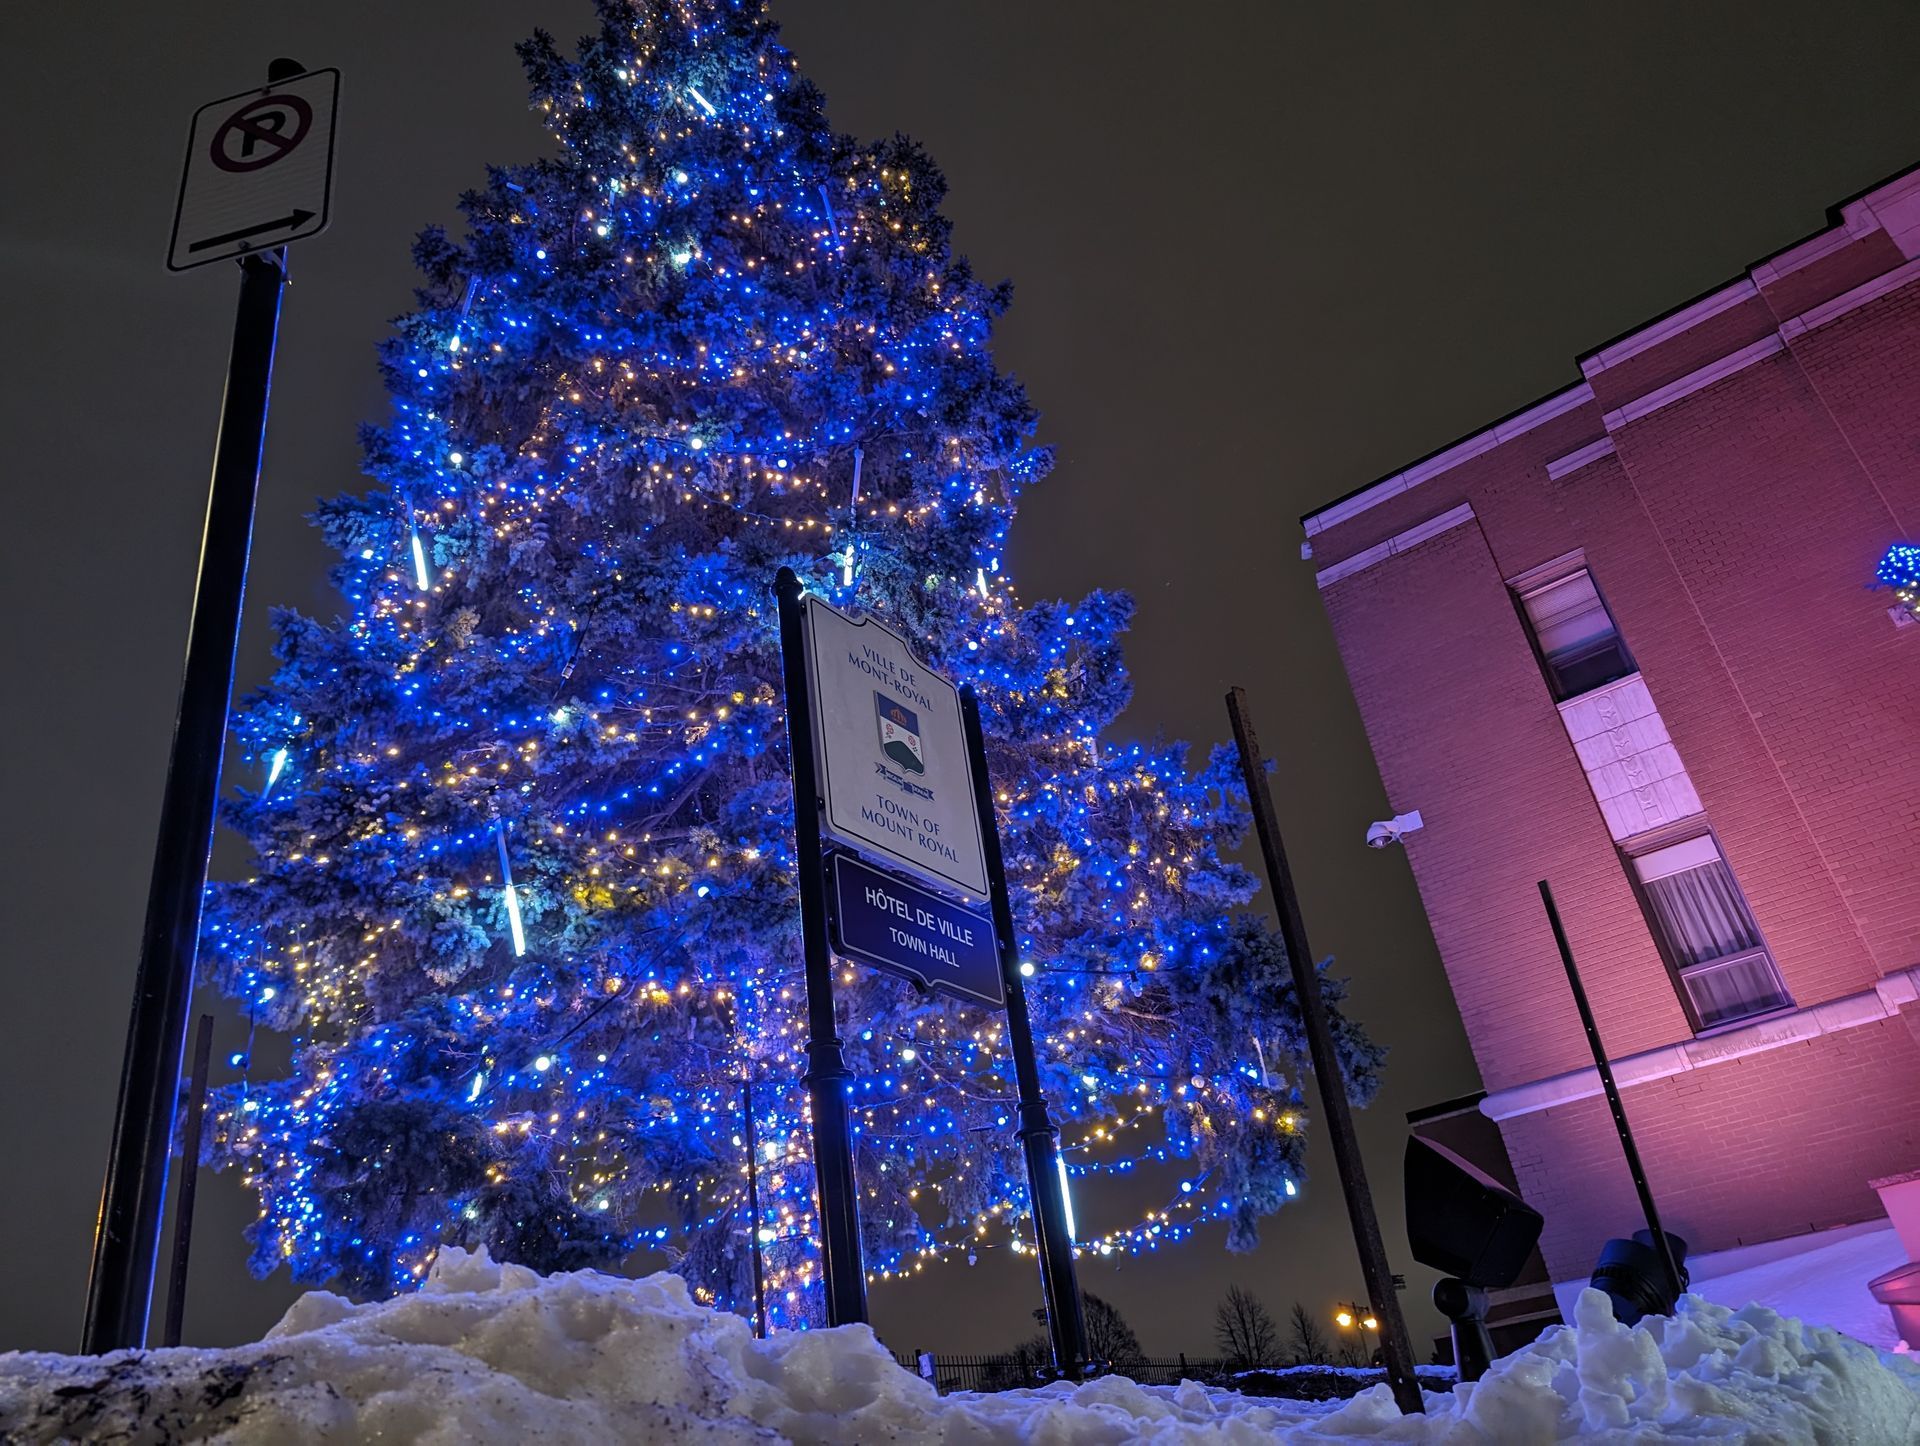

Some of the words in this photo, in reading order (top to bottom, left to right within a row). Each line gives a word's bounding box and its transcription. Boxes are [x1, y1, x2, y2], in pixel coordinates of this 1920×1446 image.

[848, 652, 933, 712] MONT-ROYAL
[862, 644, 895, 674] VILLE
[900, 668, 916, 687] DE
[861, 805, 913, 841] MOUNT
[918, 833, 959, 863] ROYAL
[876, 794, 919, 826] TOWN
[923, 818, 940, 836] OF
[865, 886, 914, 922] HÔTEL
[916, 908, 936, 931] DE
[937, 917, 974, 947] VILLE
[889, 927, 927, 955] TOWN
[929, 943, 960, 968] HALL
